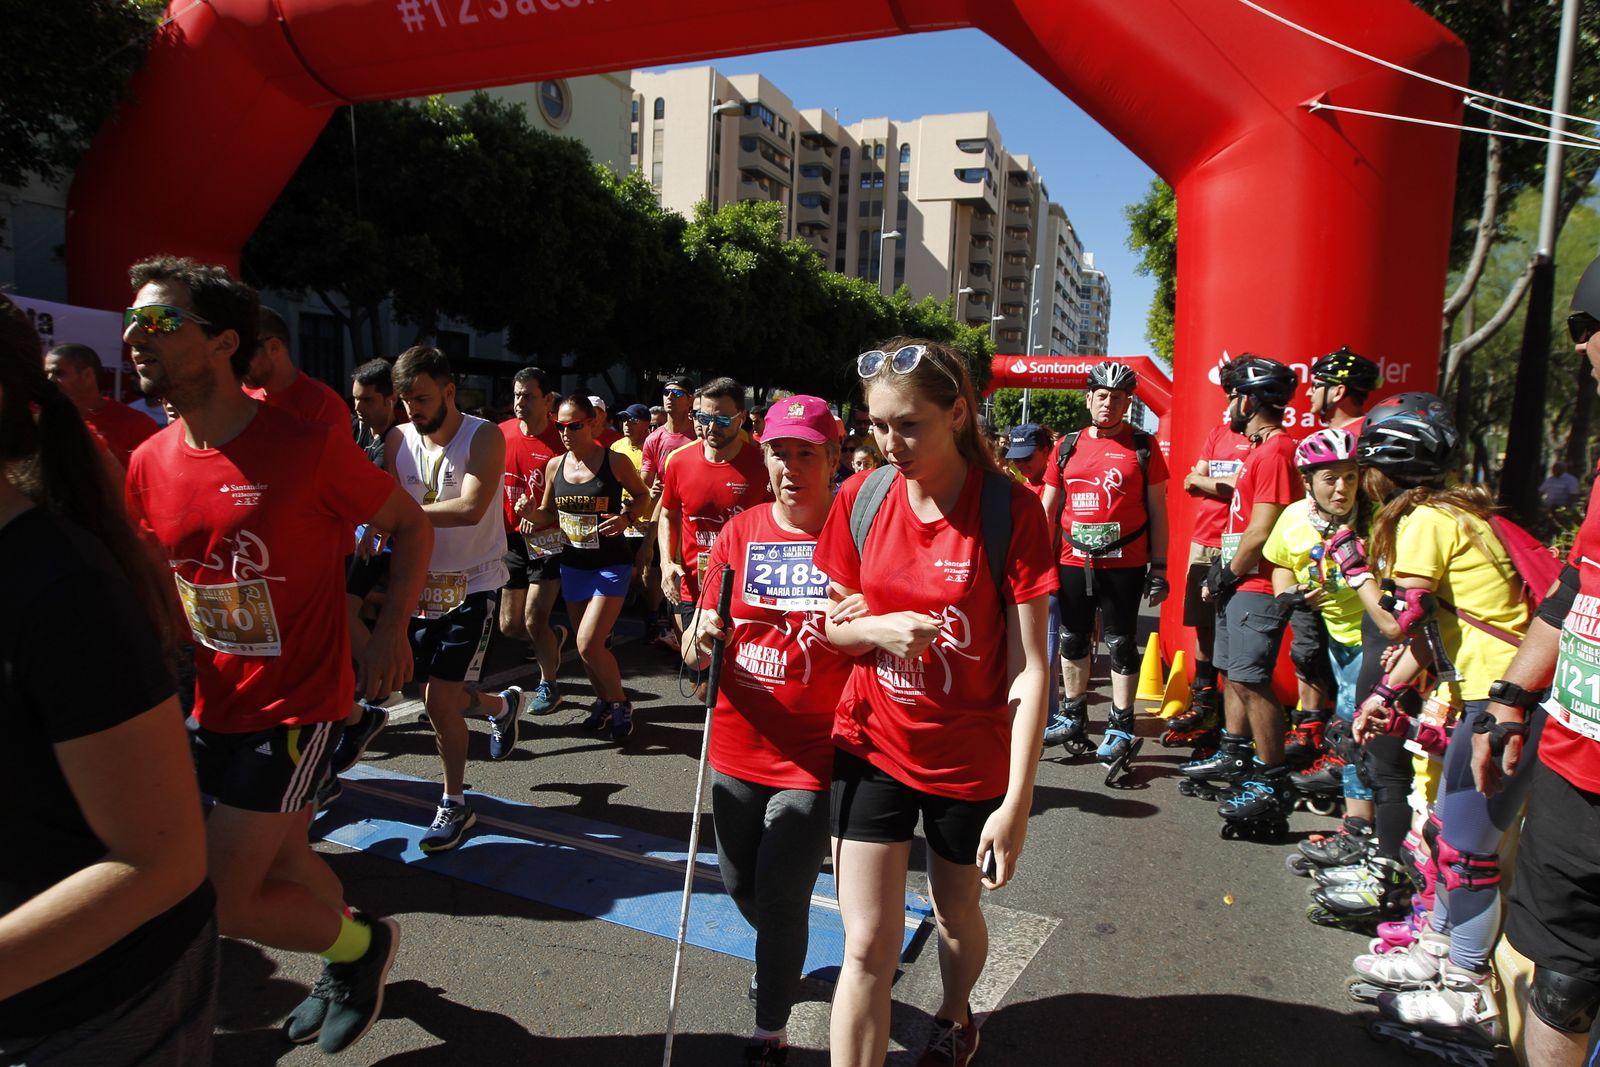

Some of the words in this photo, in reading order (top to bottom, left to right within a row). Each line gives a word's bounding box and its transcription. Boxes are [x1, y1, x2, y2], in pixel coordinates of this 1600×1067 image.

[753, 563, 828, 586] 2185
[766, 587, 790, 597] MARIA
[791, 587, 805, 596] DEL
[806, 587, 824, 596] MAR
